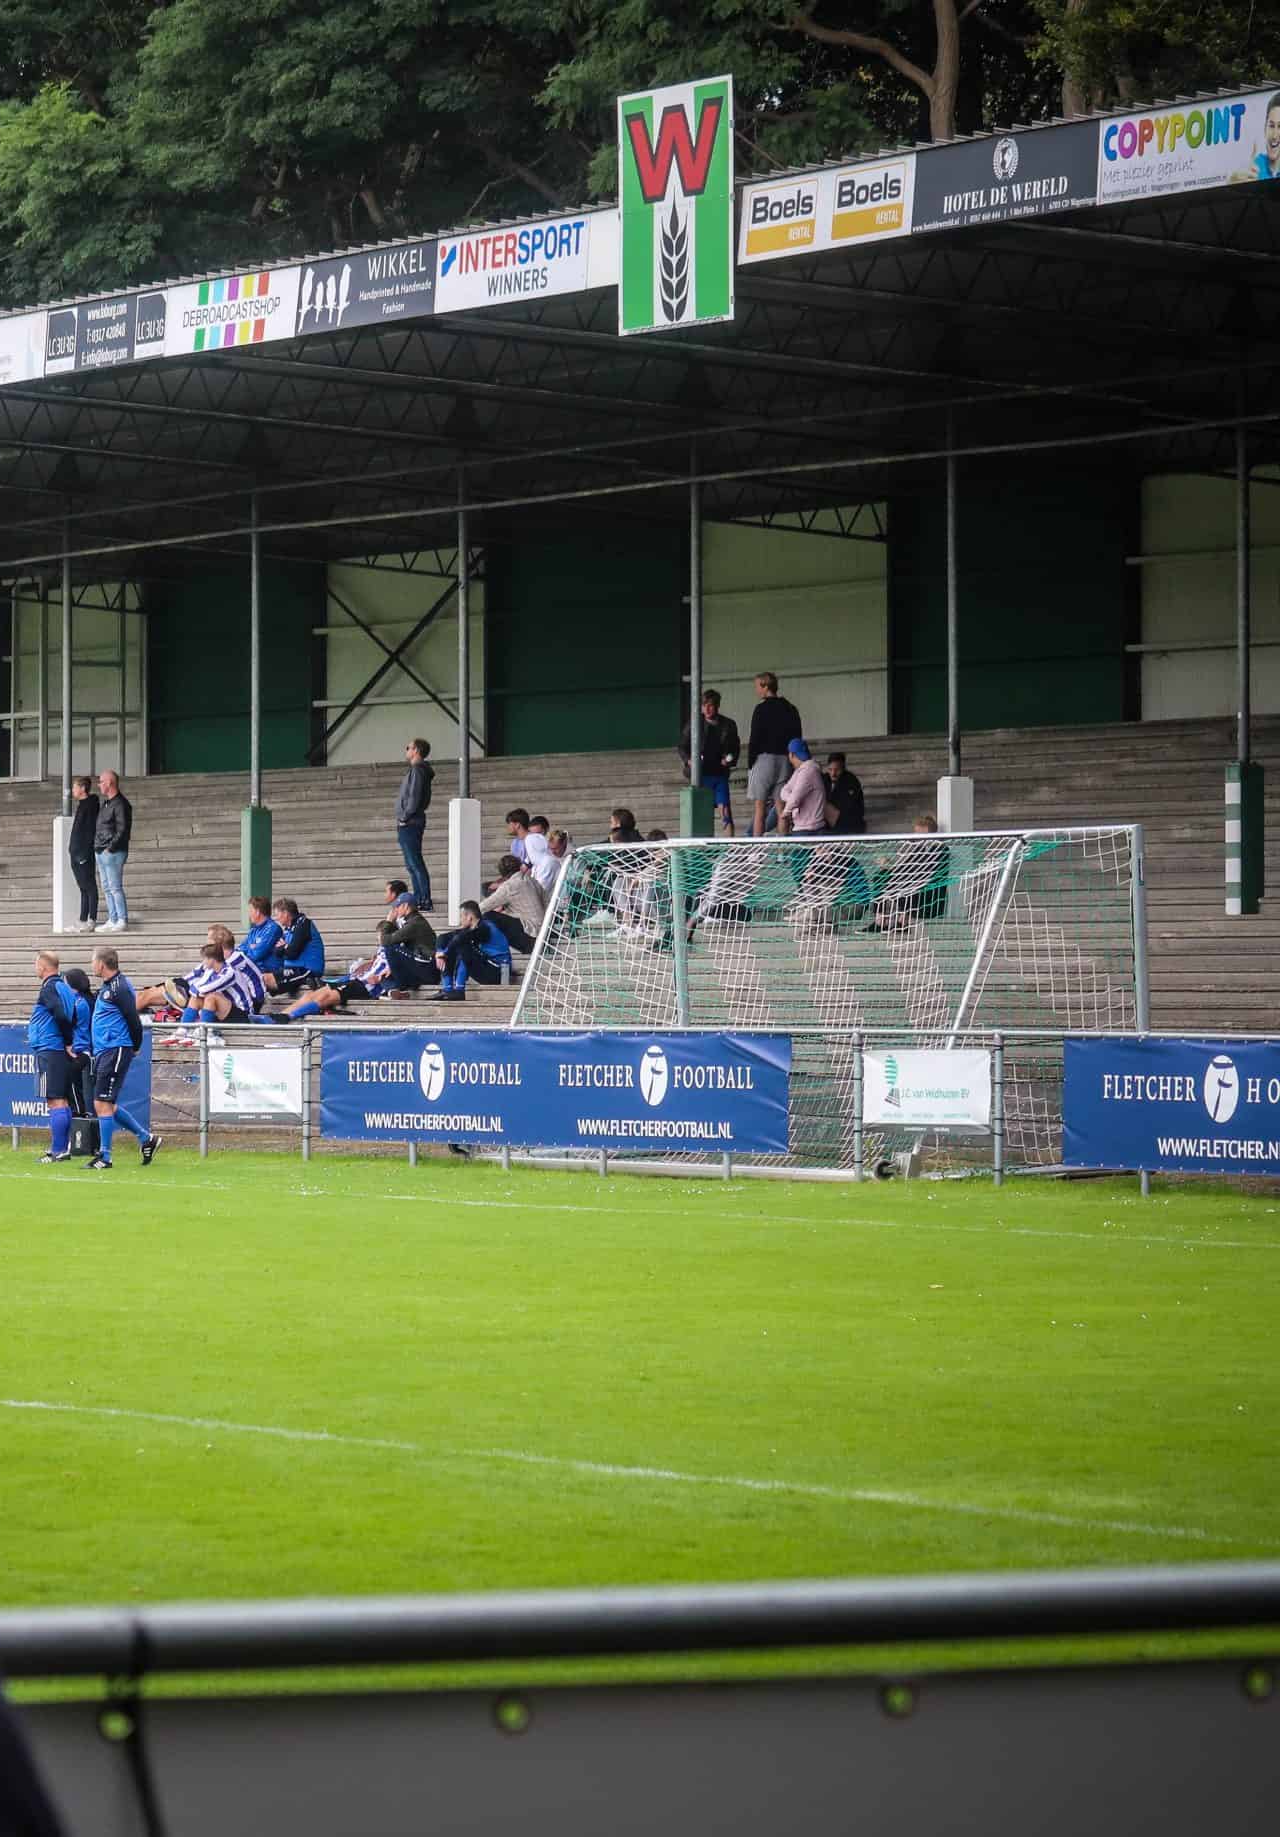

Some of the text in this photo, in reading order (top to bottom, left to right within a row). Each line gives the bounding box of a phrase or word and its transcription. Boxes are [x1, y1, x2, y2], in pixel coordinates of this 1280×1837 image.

[1104, 103, 1245, 161] COPYPOINT
[625, 96, 723, 204] W
[837, 172, 901, 208] Boels
[943, 176, 1068, 214] HOTEL DE WERELD
[751, 189, 813, 224] Boels
[458, 221, 585, 275] INTERSPORT
[367, 248, 426, 281] WIKKEL
[488, 267, 548, 297] WINNERS
[182, 297, 281, 328] DEBROADCASTSHOP
[348, 1060, 522, 1086] FLETCHER FOOTBALL
[558, 1064, 754, 1090] FLETCHER FOOTBALL
[1103, 1074, 1197, 1102] FLETCHER
[364, 1112, 504, 1133] WWW.FLETCHERFOOTBALL.NL
[577, 1118, 734, 1140] WWW.FLETCHERFOOTBALL.NL
